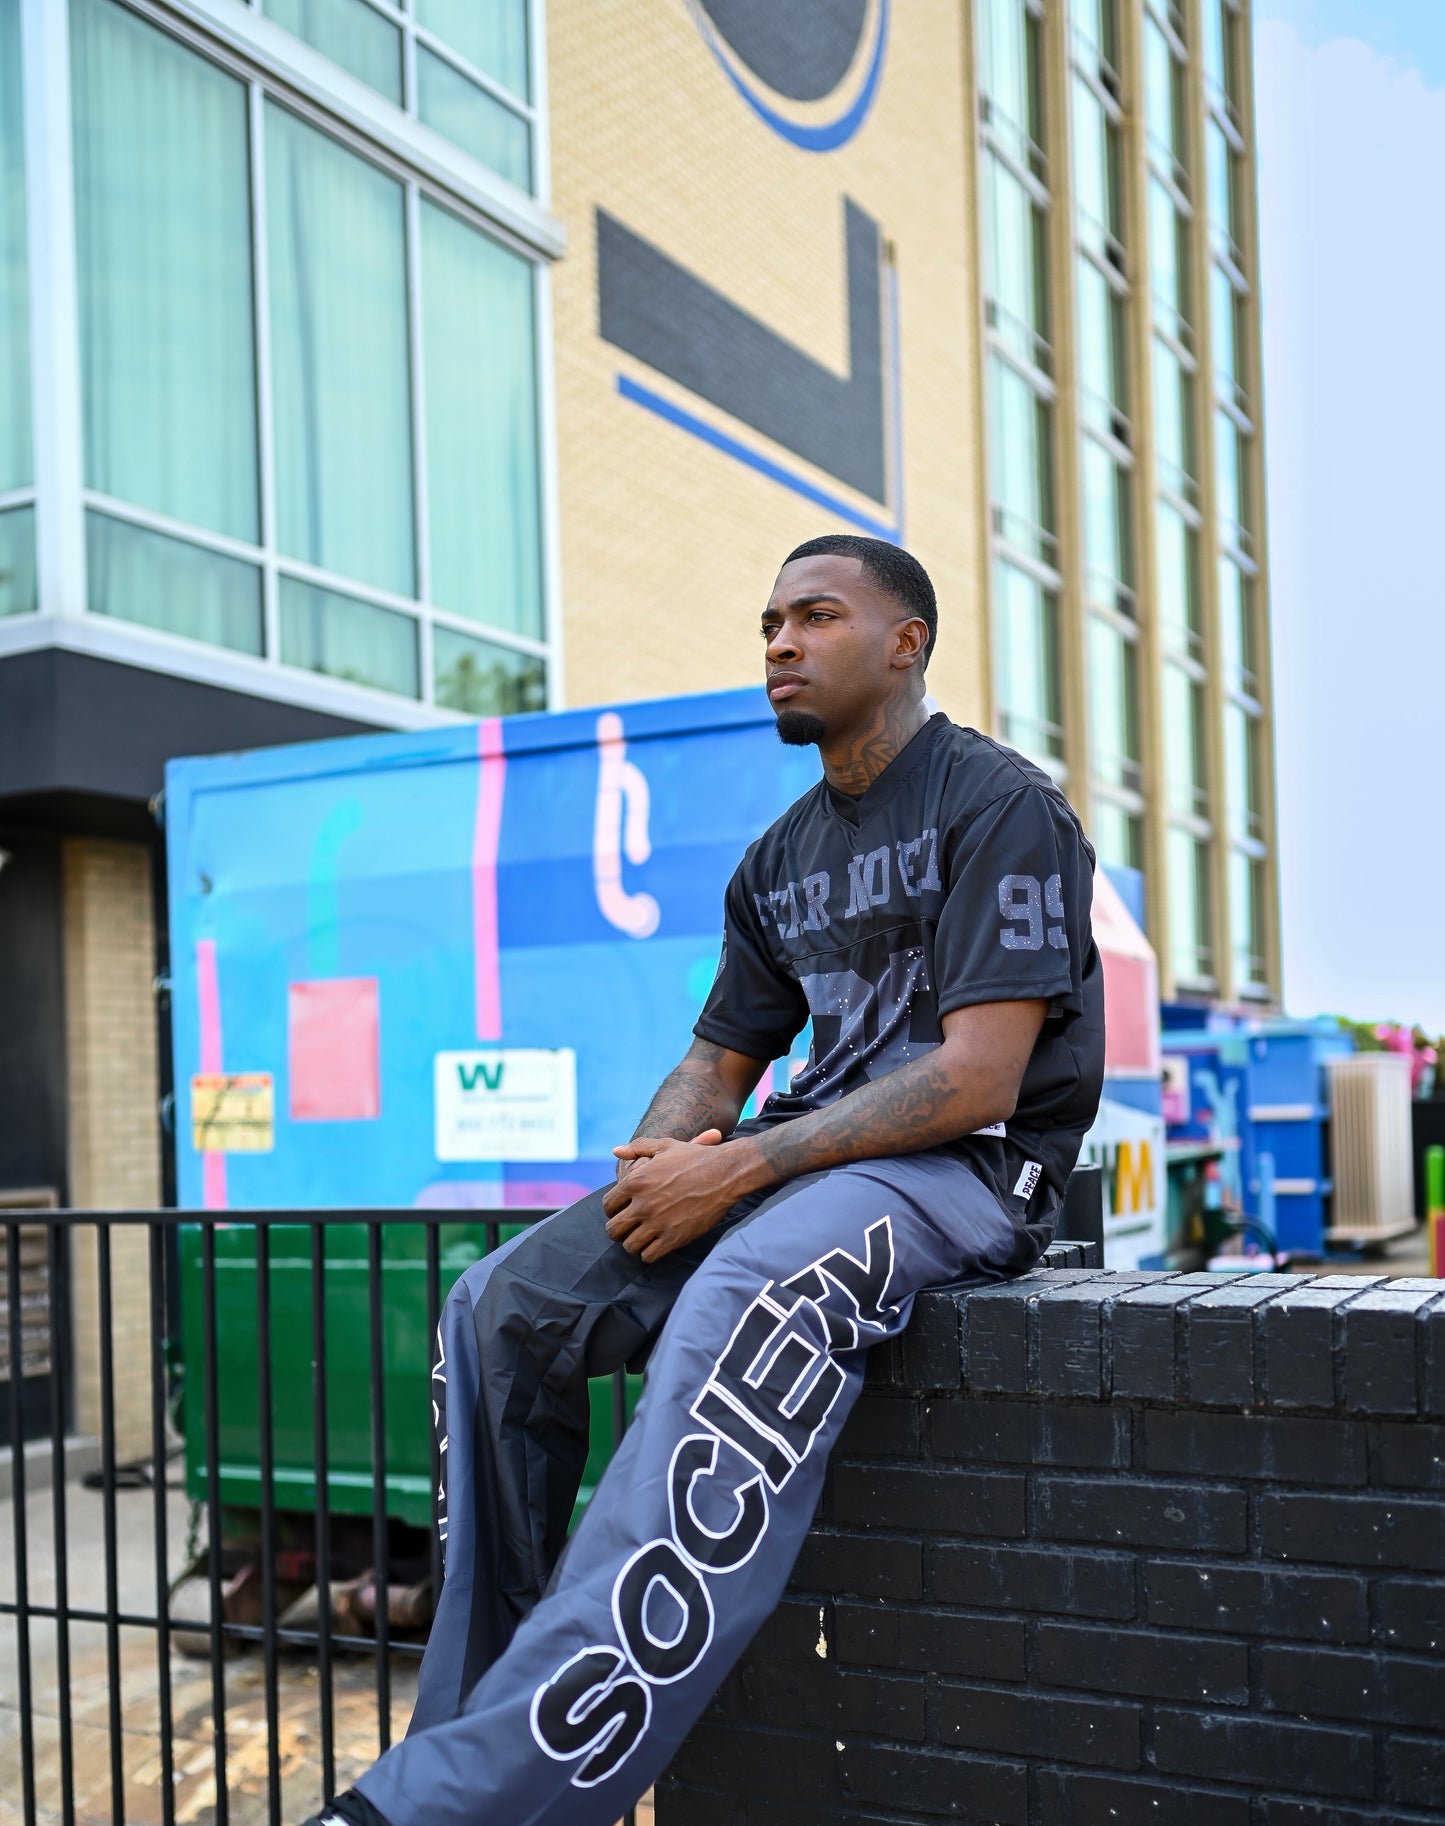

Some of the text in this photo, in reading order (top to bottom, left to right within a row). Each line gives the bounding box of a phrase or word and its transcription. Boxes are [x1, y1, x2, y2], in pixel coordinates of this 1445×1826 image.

[844, 846, 890, 919] NO
[1022, 1165, 1041, 1196] PEACE
[530, 1215, 901, 1788] SOCIETY
